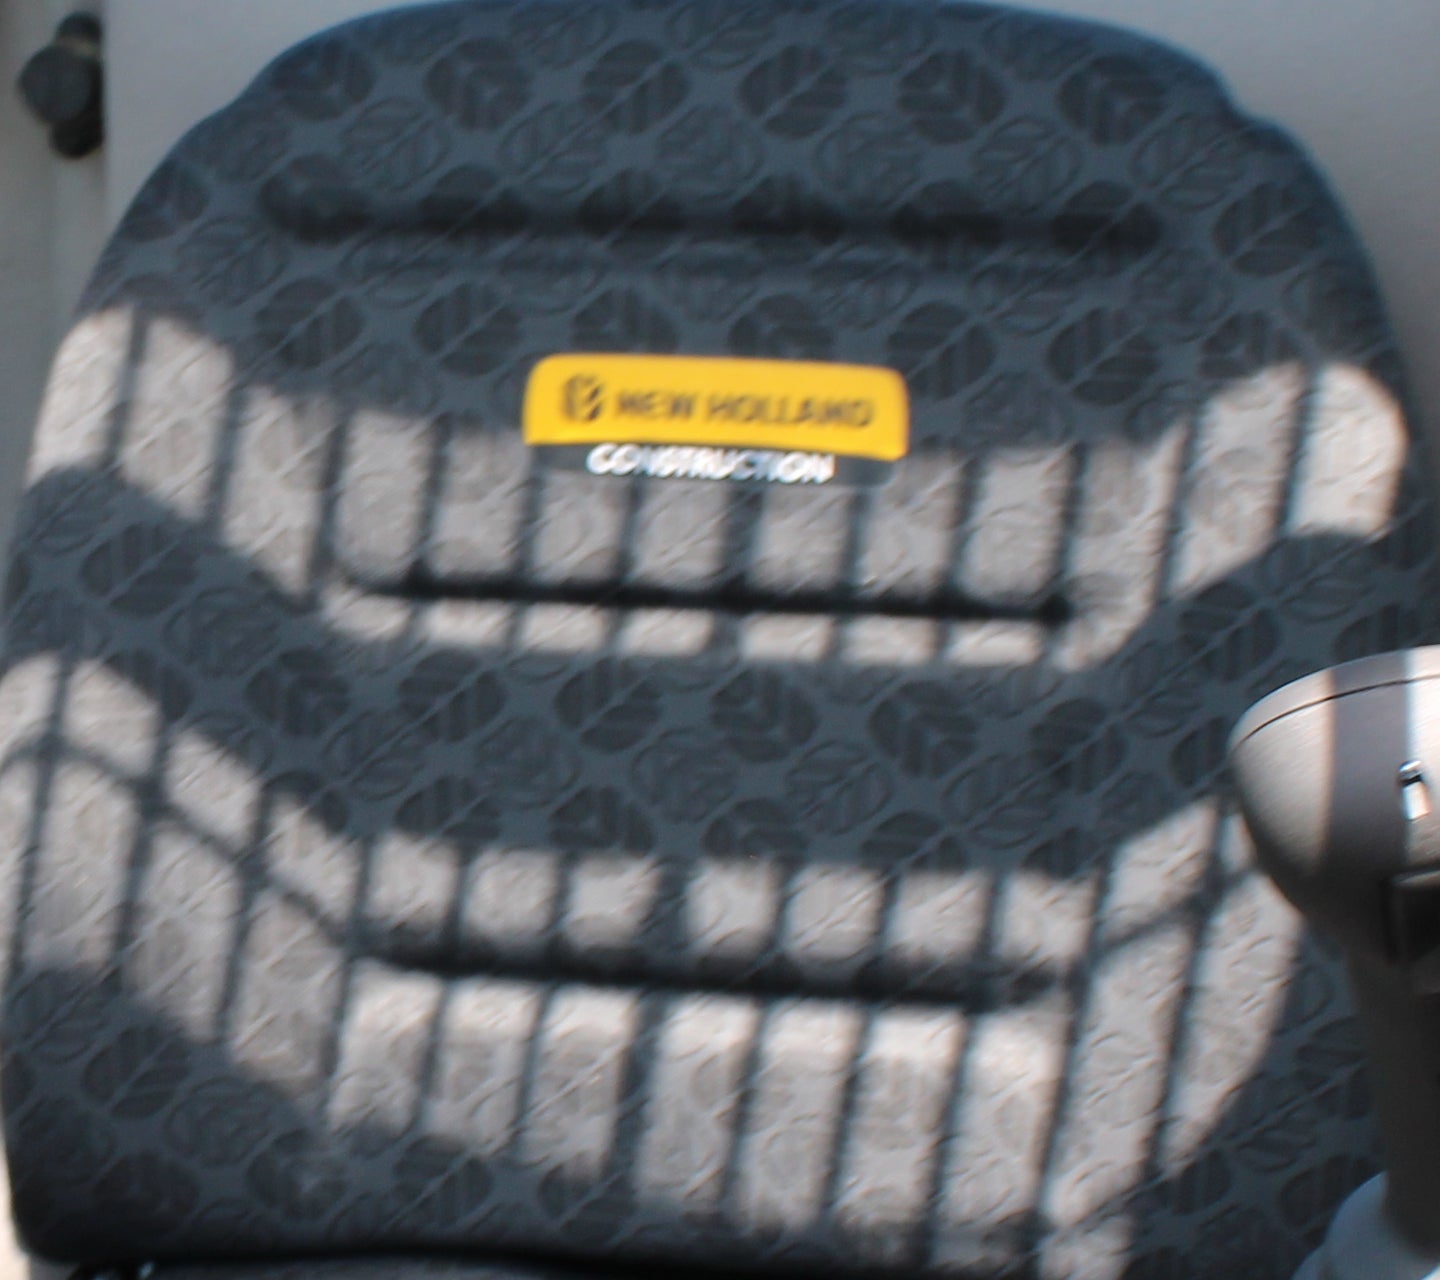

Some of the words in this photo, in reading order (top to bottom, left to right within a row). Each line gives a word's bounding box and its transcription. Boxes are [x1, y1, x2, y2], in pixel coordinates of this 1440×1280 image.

[614, 389, 695, 422] NEW
[706, 391, 874, 428] HOLLAND
[586, 442, 836, 483] CONSTRUCTION
